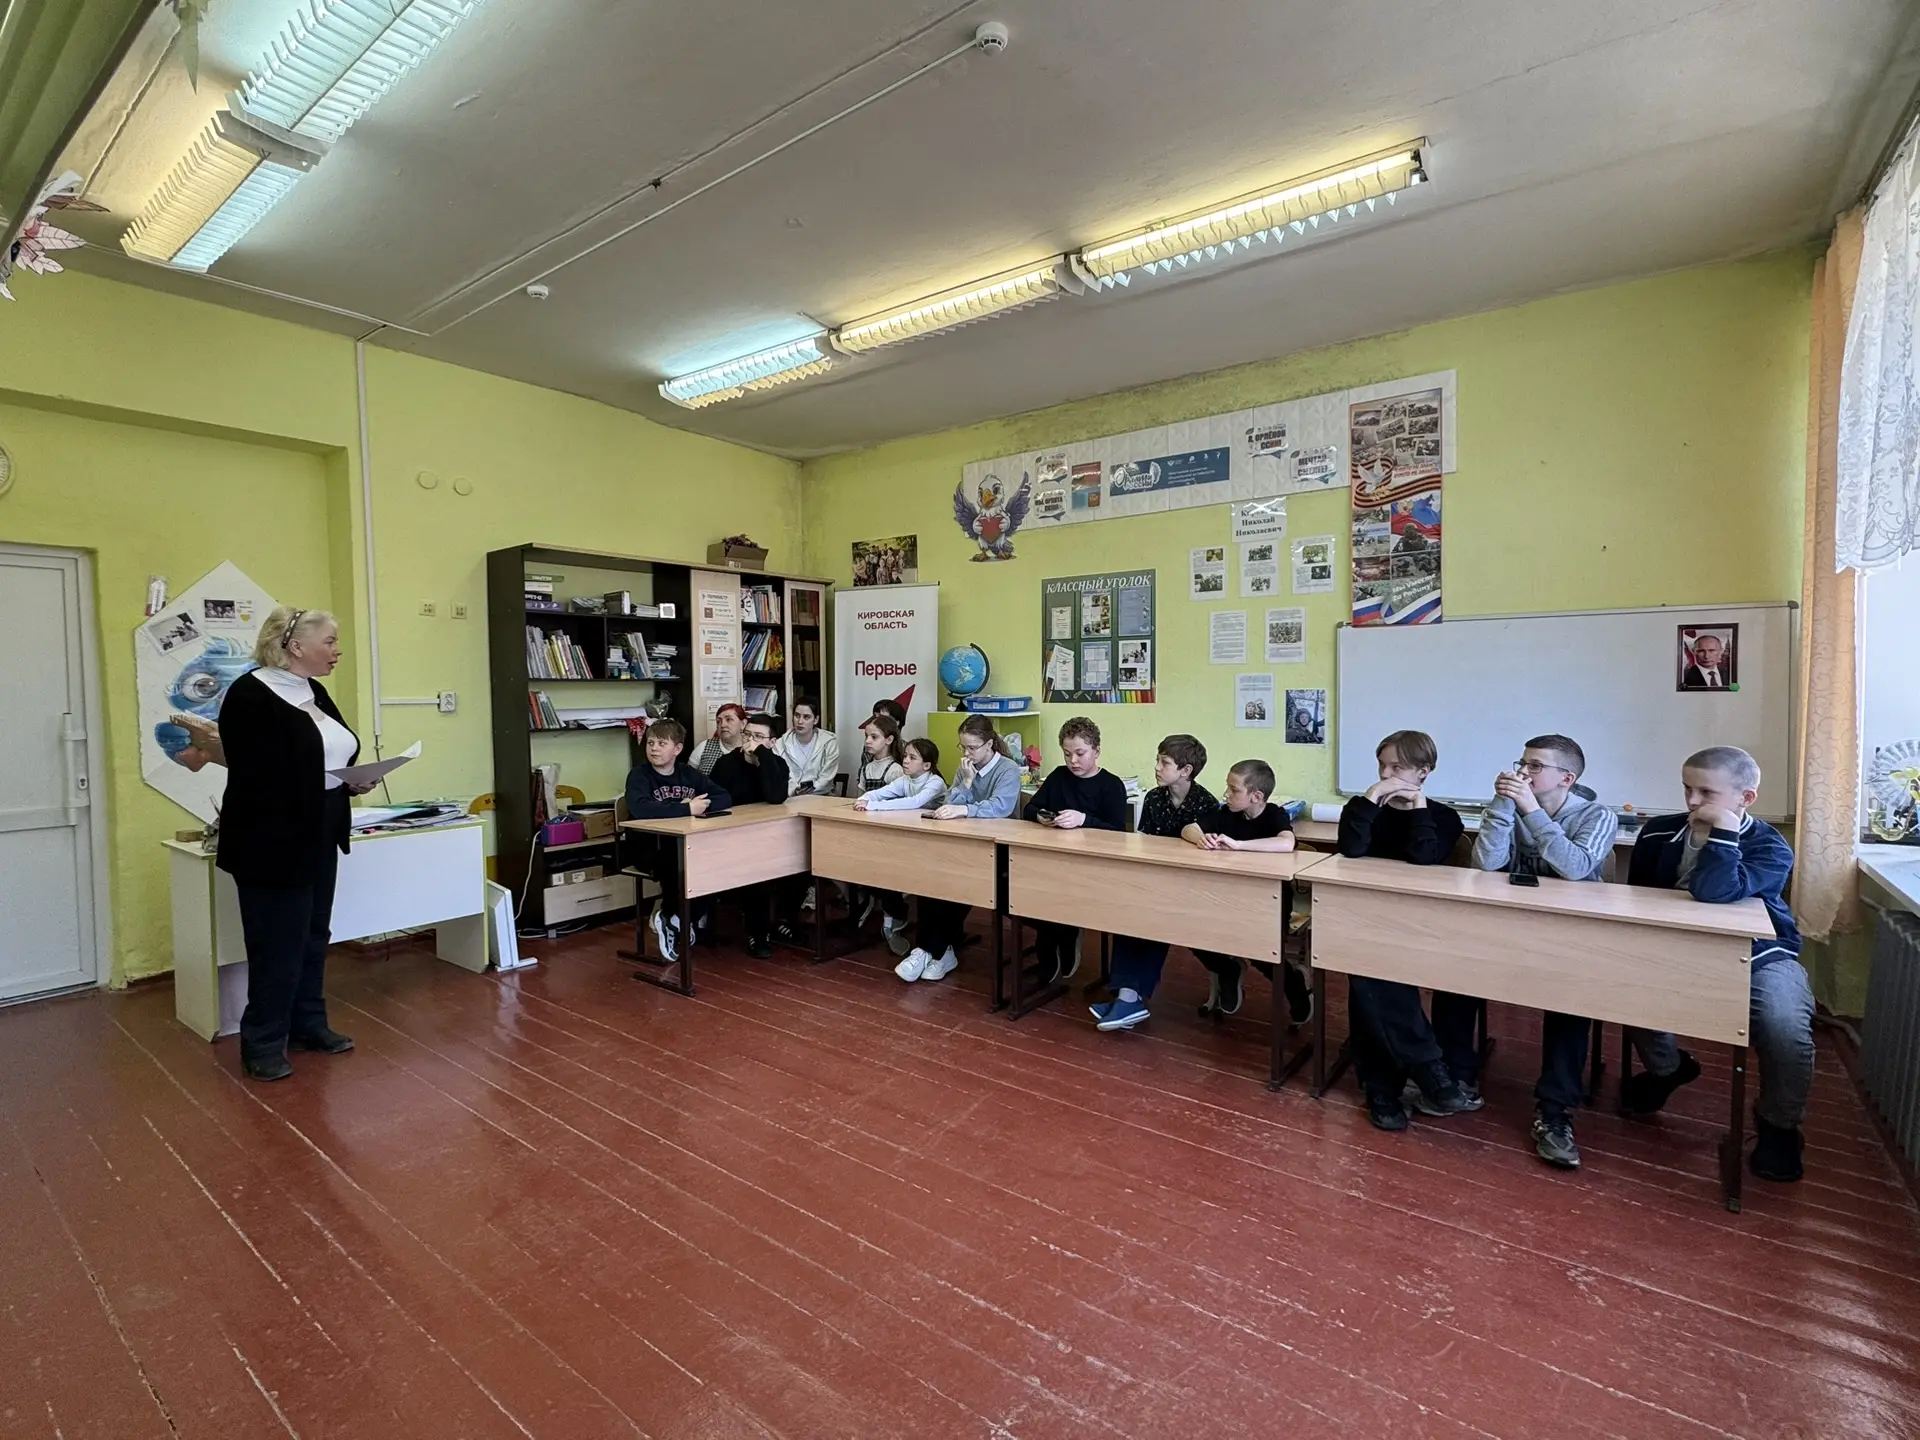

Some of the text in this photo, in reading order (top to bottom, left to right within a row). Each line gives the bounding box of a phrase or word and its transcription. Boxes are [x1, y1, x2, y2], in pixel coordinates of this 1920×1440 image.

[1046, 577, 1104, 594] КЛАССНЫЙ
[1104, 575, 1152, 589] УГОЛОК
[857, 609, 915, 620] КИРОВСКАЯ
[864, 621, 908, 630] ОБЛАСТЬ
[855, 660, 917, 681] Первые
